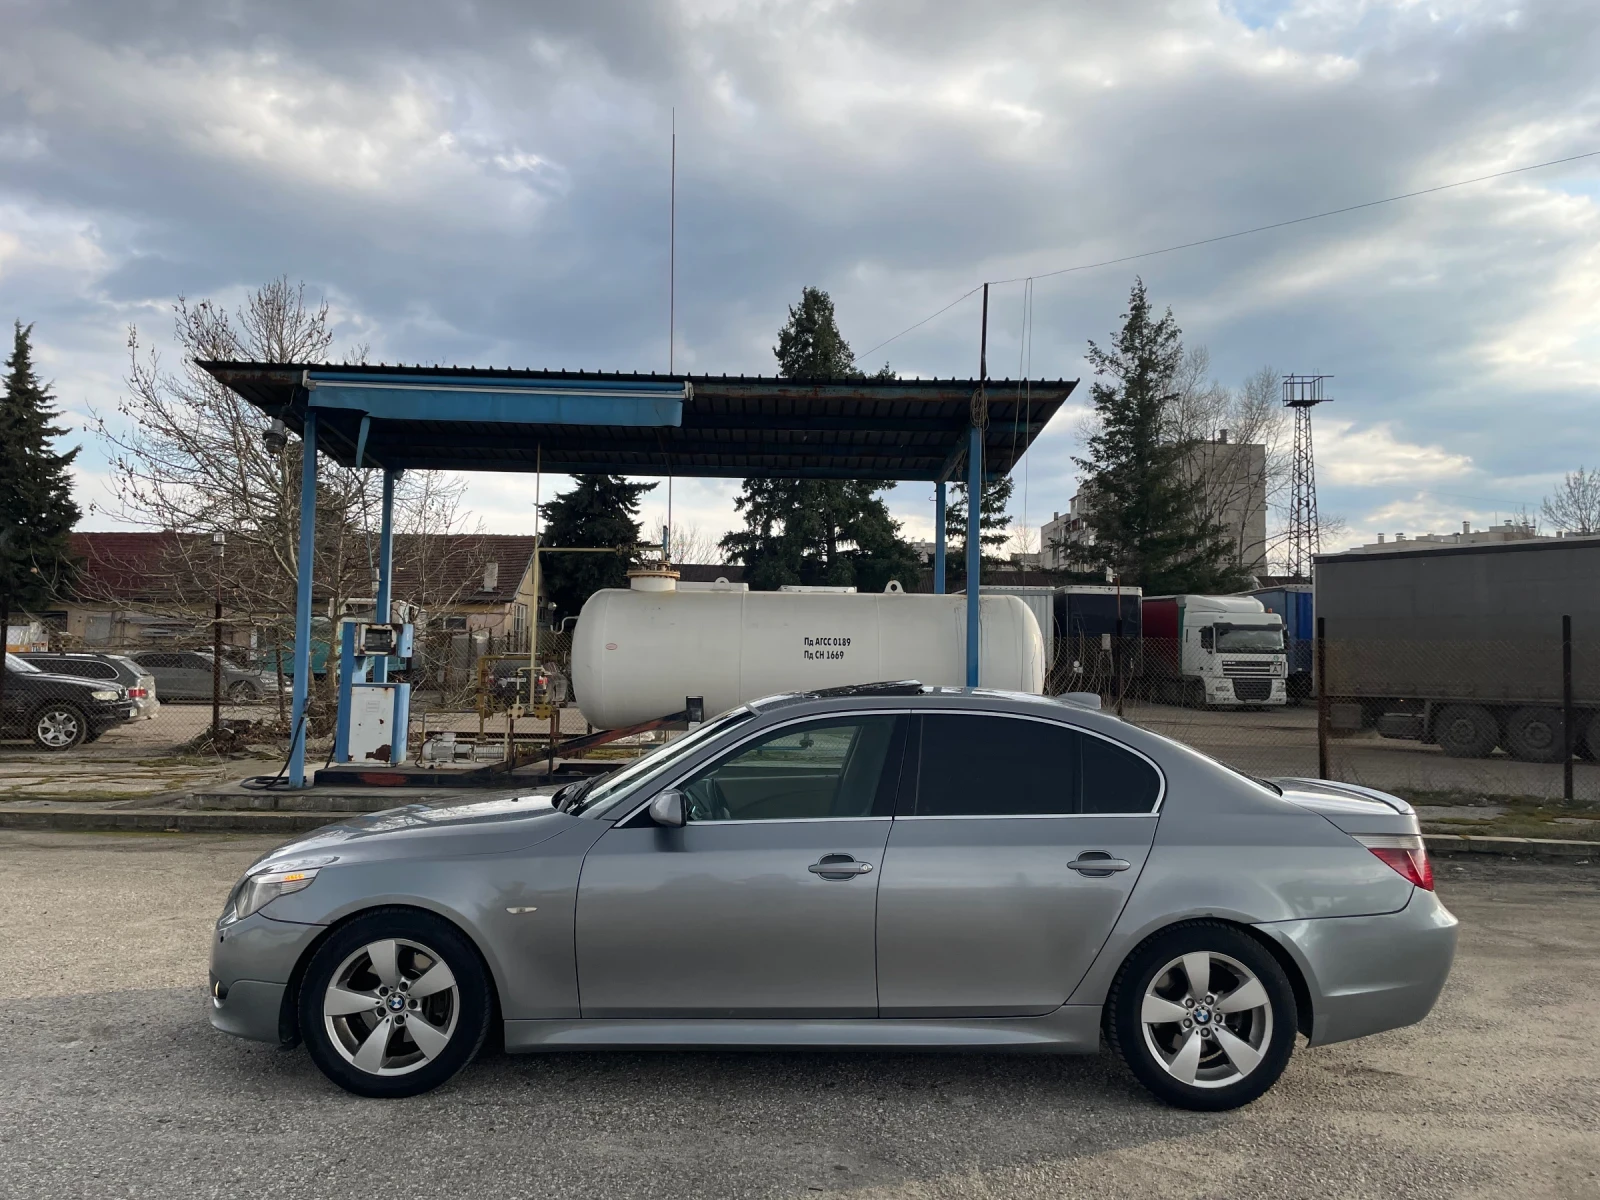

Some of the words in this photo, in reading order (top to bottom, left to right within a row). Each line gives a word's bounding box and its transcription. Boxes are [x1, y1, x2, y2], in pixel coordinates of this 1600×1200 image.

[804, 637, 814, 647] Пд
[815, 638, 832, 646] АГСС
[833, 638, 851, 647] 0189
[804, 650, 814, 660] Пд
[815, 650, 825, 660] СН
[826, 650, 844, 660] 1669
